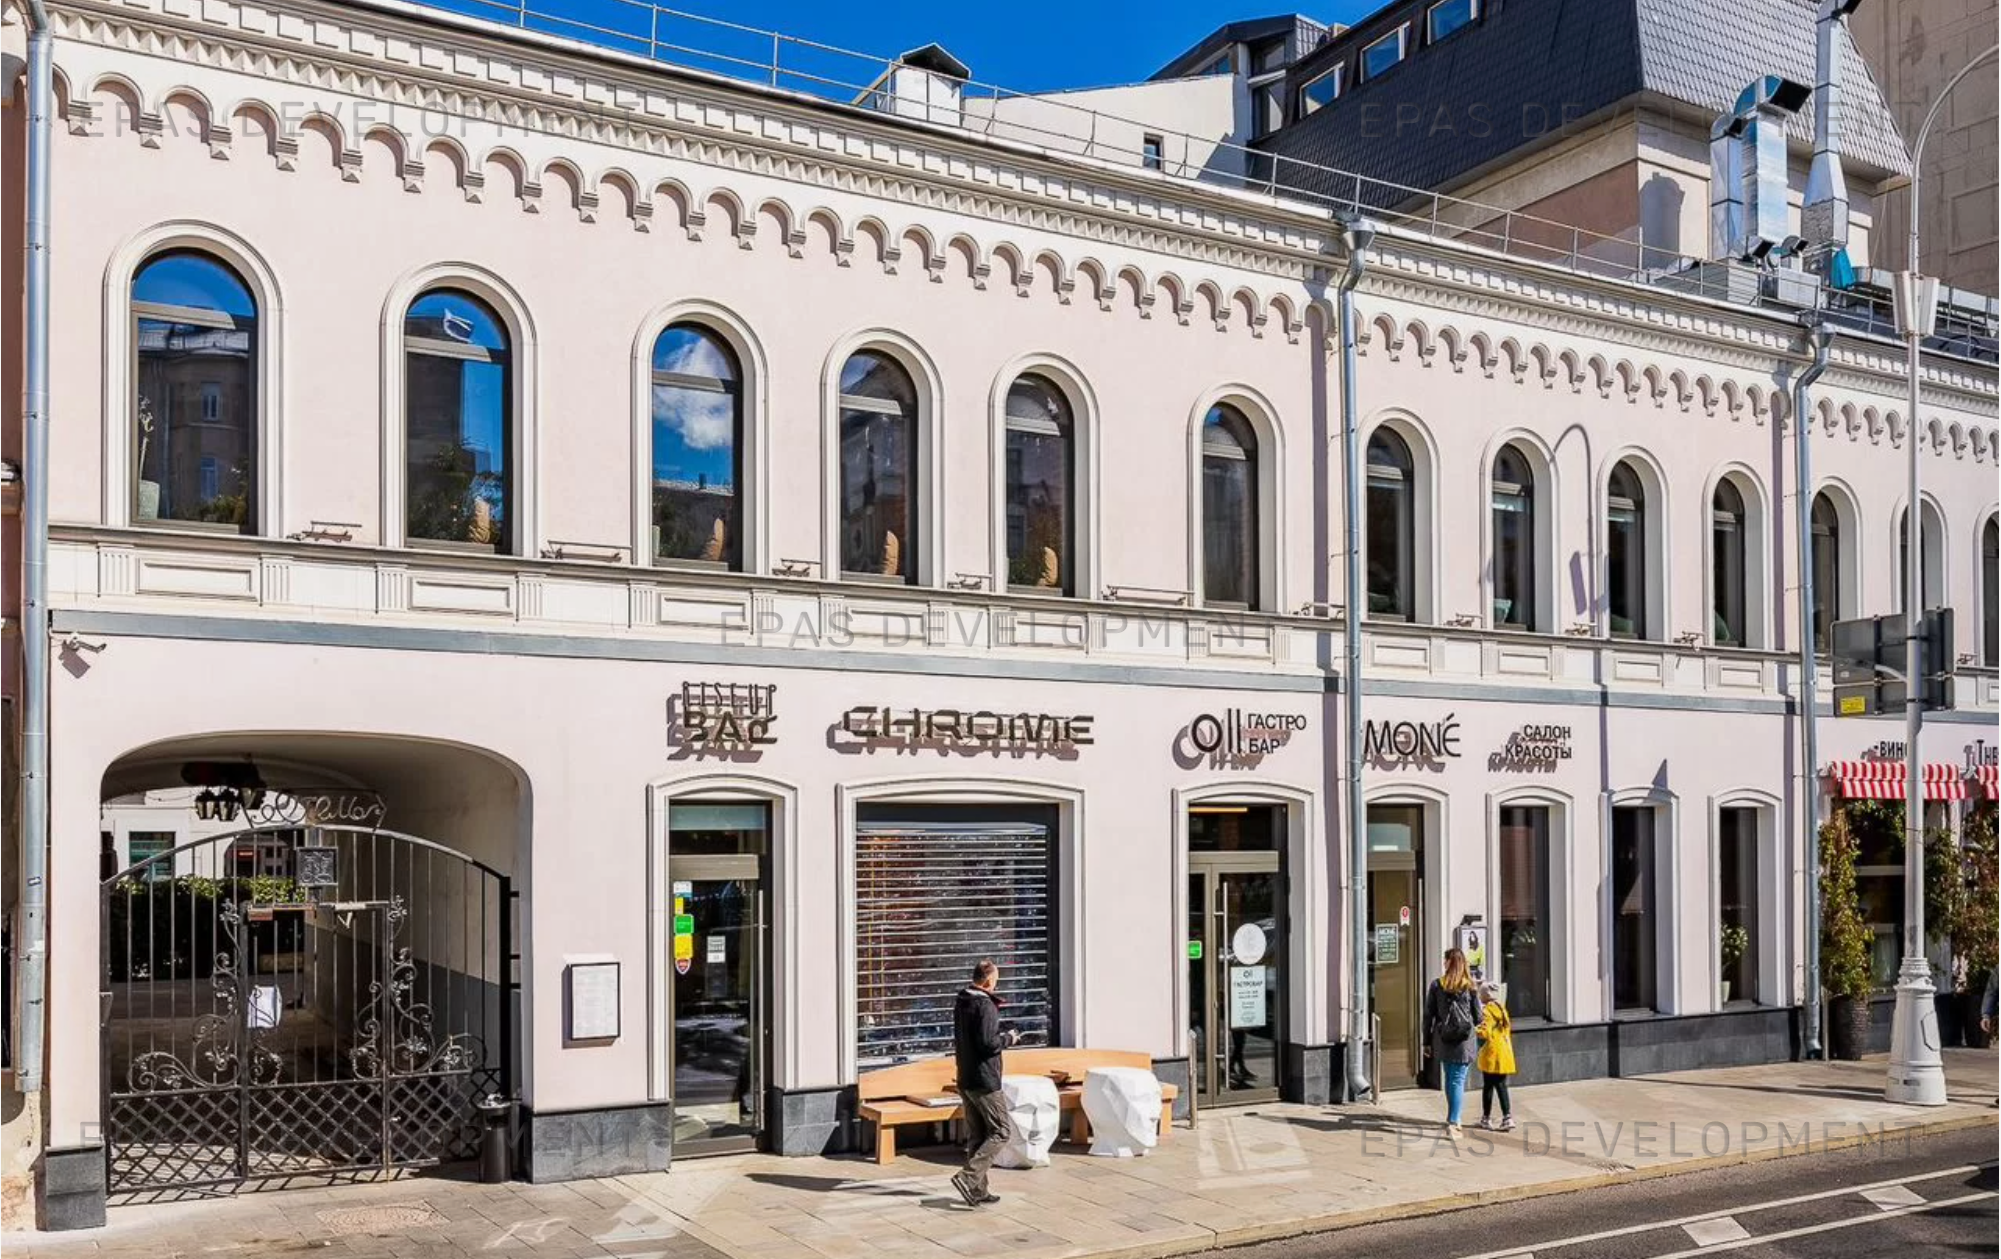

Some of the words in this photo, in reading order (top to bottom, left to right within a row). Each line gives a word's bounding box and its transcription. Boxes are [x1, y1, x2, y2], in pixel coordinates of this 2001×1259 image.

[683, 711, 778, 744] BAR
[843, 706, 1095, 745] CHROME
[1248, 713, 1307, 730] ГАСТРО
[1364, 713, 1461, 757] MONÉ
[1523, 724, 1571, 739] САЛОН
[1249, 738, 1281, 754] БАР
[1505, 744, 1572, 759] КРАСОТЫ
